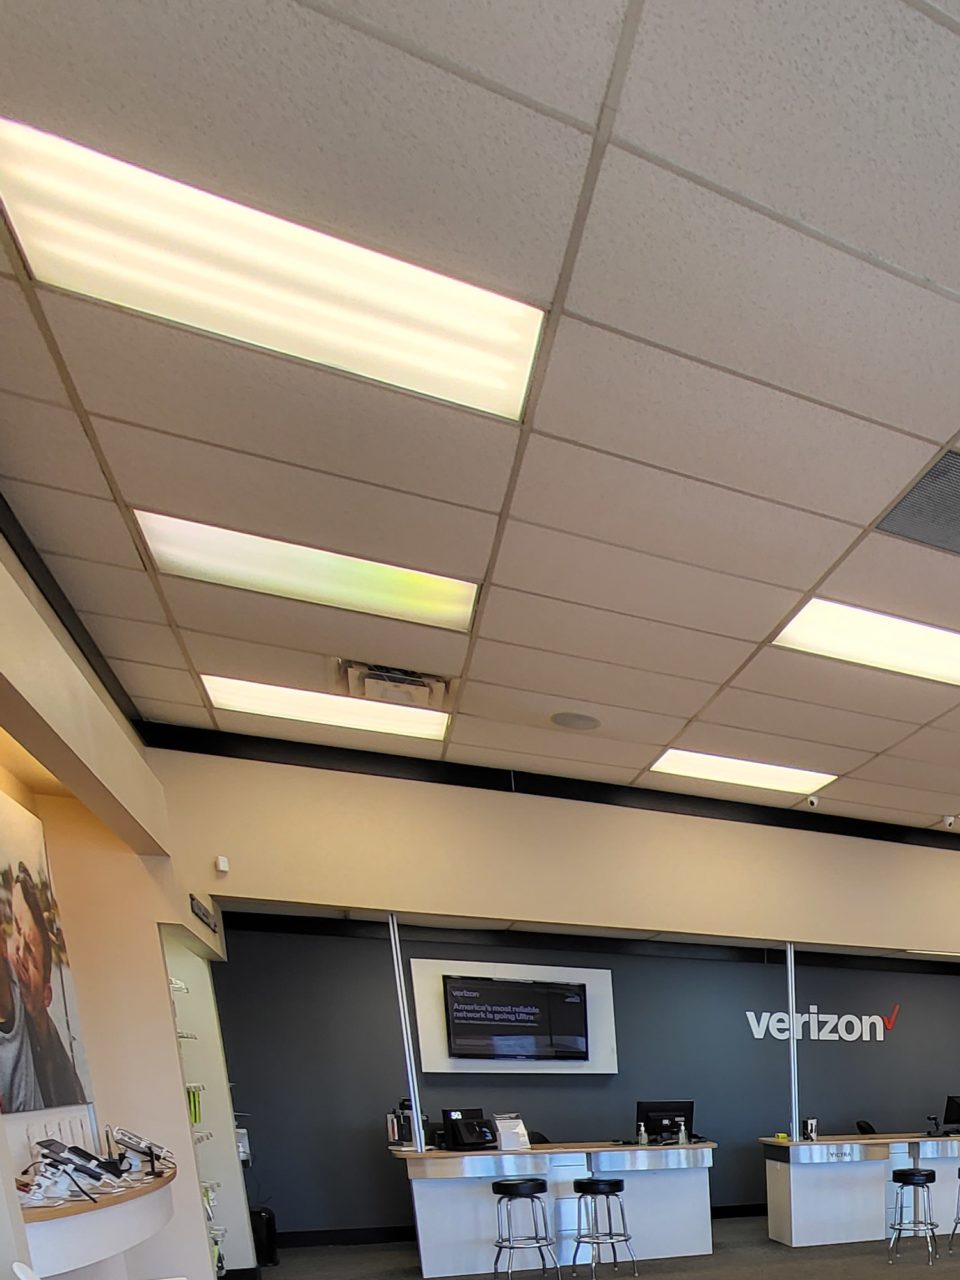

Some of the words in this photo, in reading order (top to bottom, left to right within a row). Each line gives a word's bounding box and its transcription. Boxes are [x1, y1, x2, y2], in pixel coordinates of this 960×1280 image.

[452, 990, 480, 998] verizon
[453, 1003, 492, 1012] America's
[453, 1011, 488, 1019] network
[745, 1005, 885, 1041] verizon
